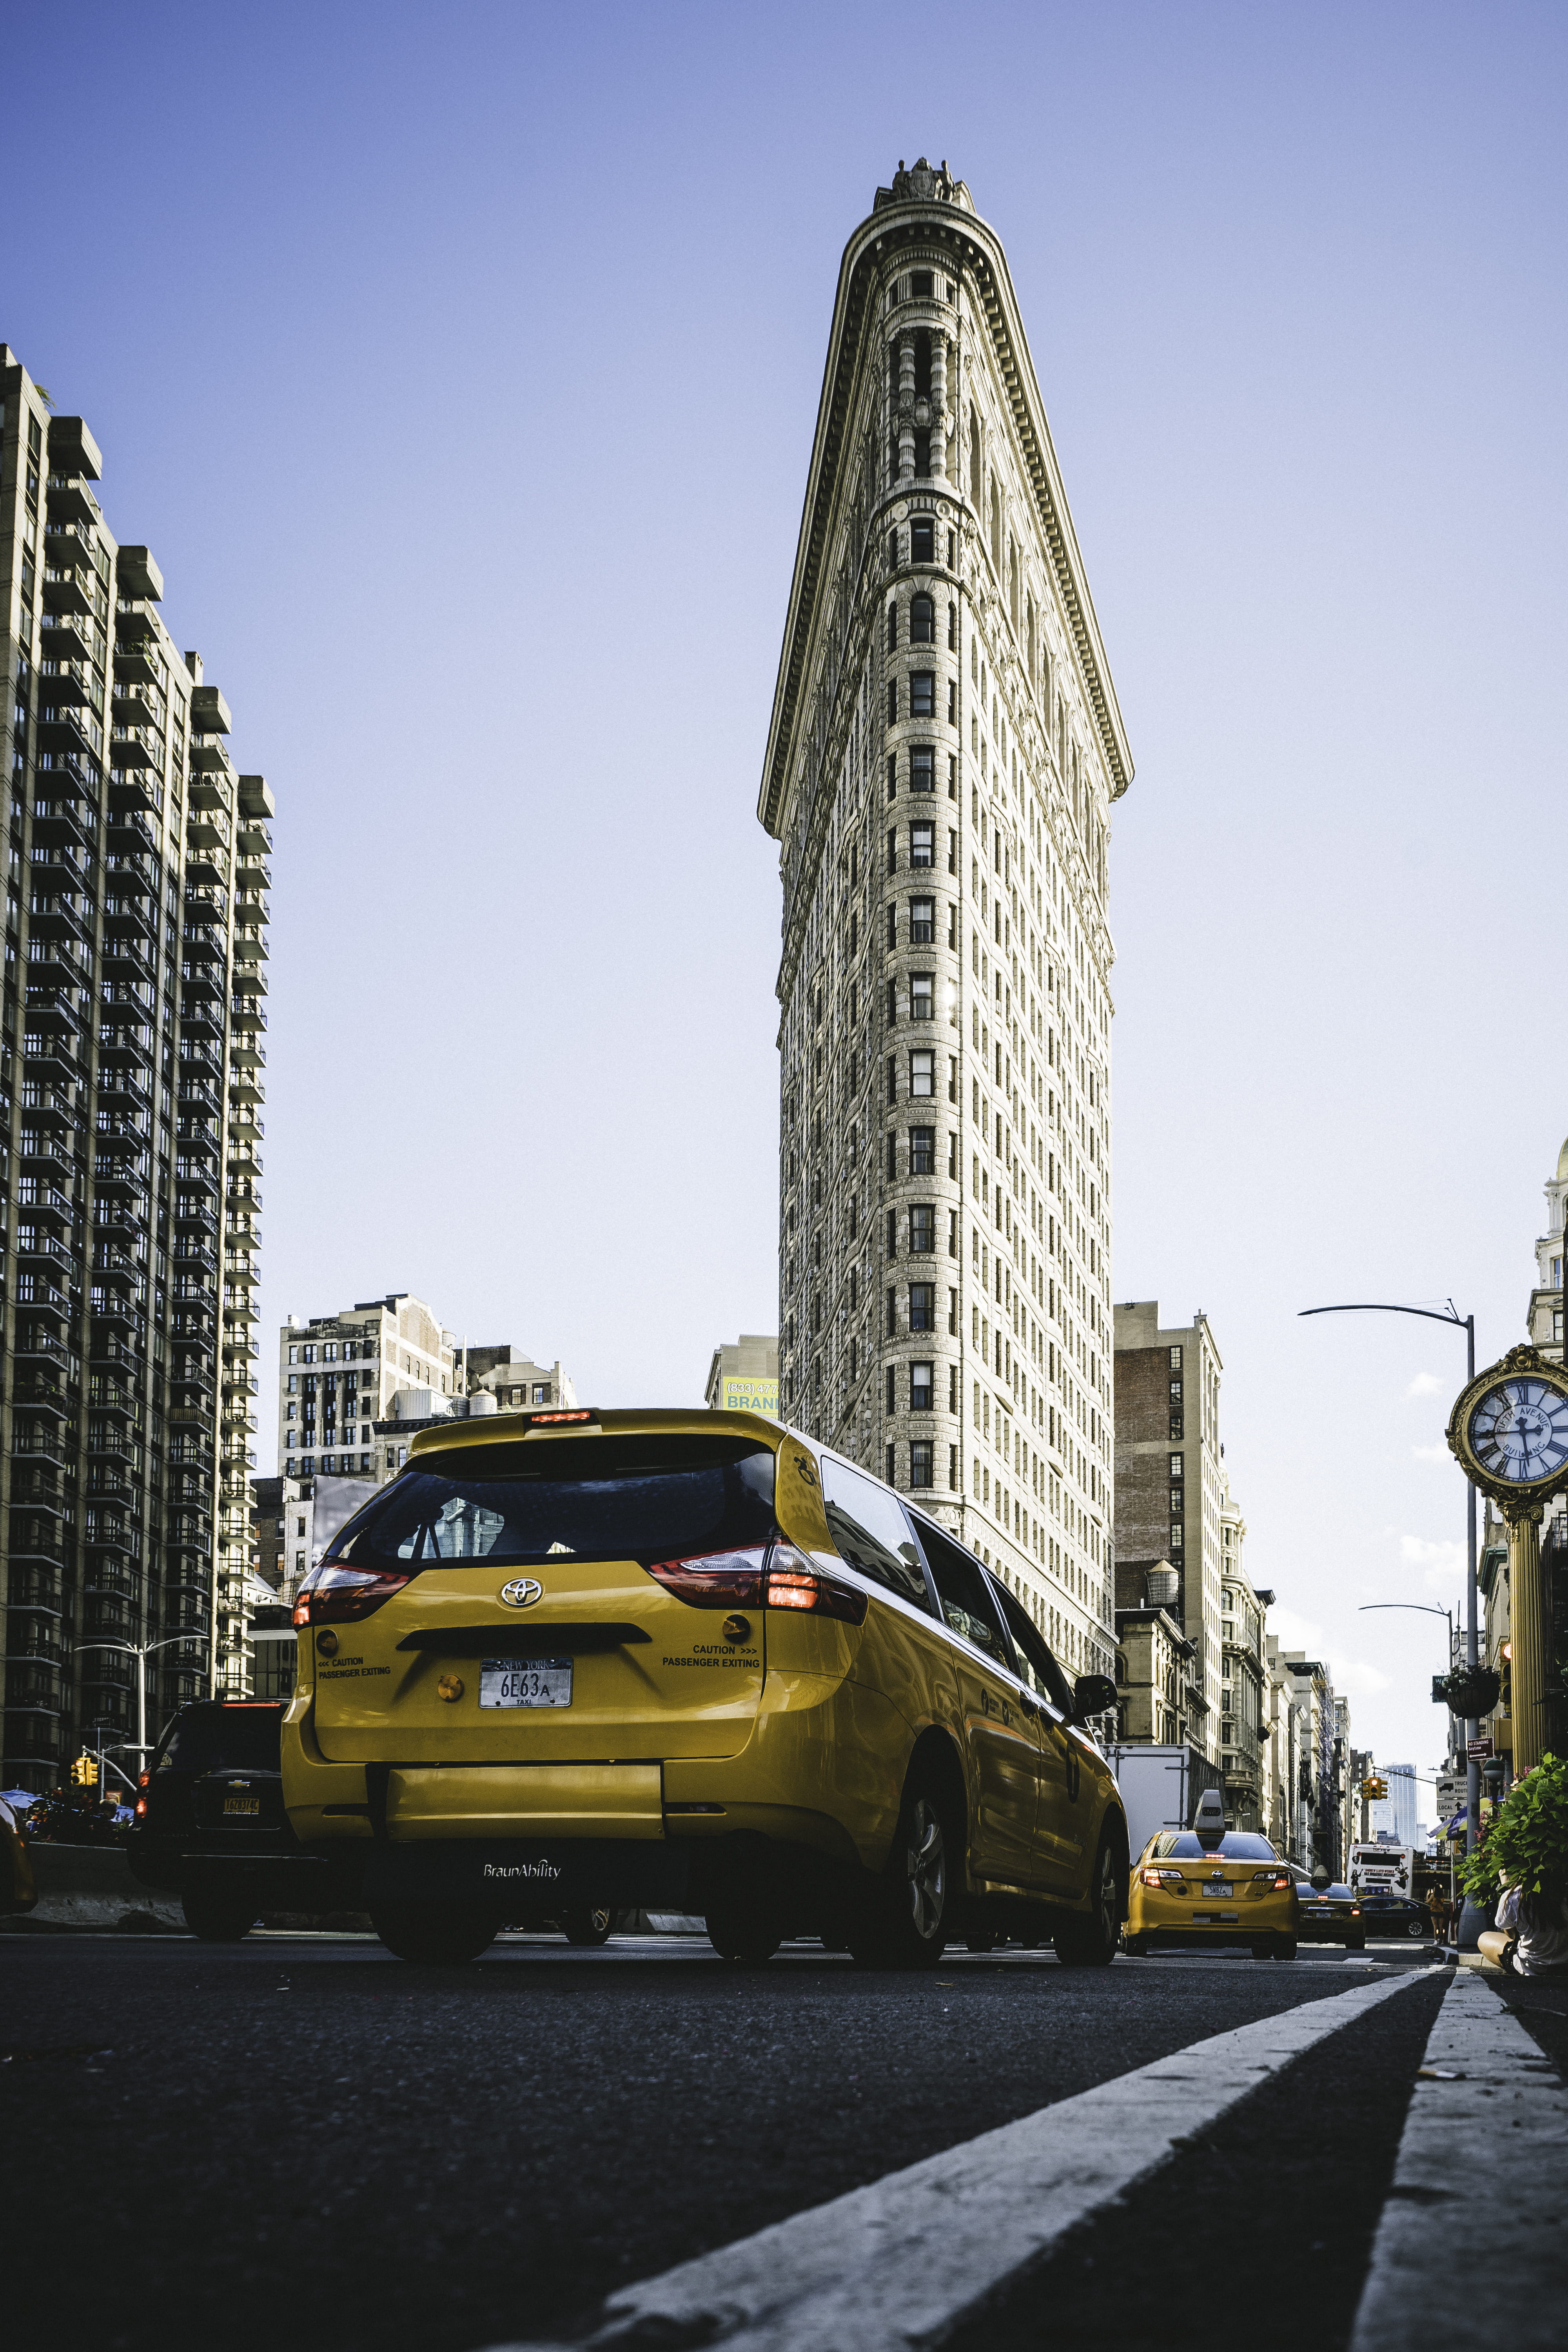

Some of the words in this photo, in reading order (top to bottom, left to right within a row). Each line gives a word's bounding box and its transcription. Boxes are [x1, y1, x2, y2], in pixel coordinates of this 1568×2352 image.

[727, 1382, 755, 1395] (833)
[756, 1384, 778, 1394] 477
[1497, 1410, 1515, 1433] FIFTH
[1520, 1407, 1550, 1428] AVENUE
[1503, 1441, 1545, 1457] BUILING
[693, 1644, 736, 1655] CAUTION
[332, 1657, 364, 1667] CAUTION
[503, 1661, 523, 1671] NEW
[526, 1660, 550, 1670] YORK
[662, 1657, 720, 1666] PASSENGER
[722, 1659, 760, 1668] EXITING
[319, 1668, 361, 1680] PASSENGER
[361, 1666, 391, 1676] EXITING
[501, 1673, 550, 1697] 6E63A
[226, 1799, 259, 1810] T628374C
[484, 1860, 561, 1880] BraunAbility
